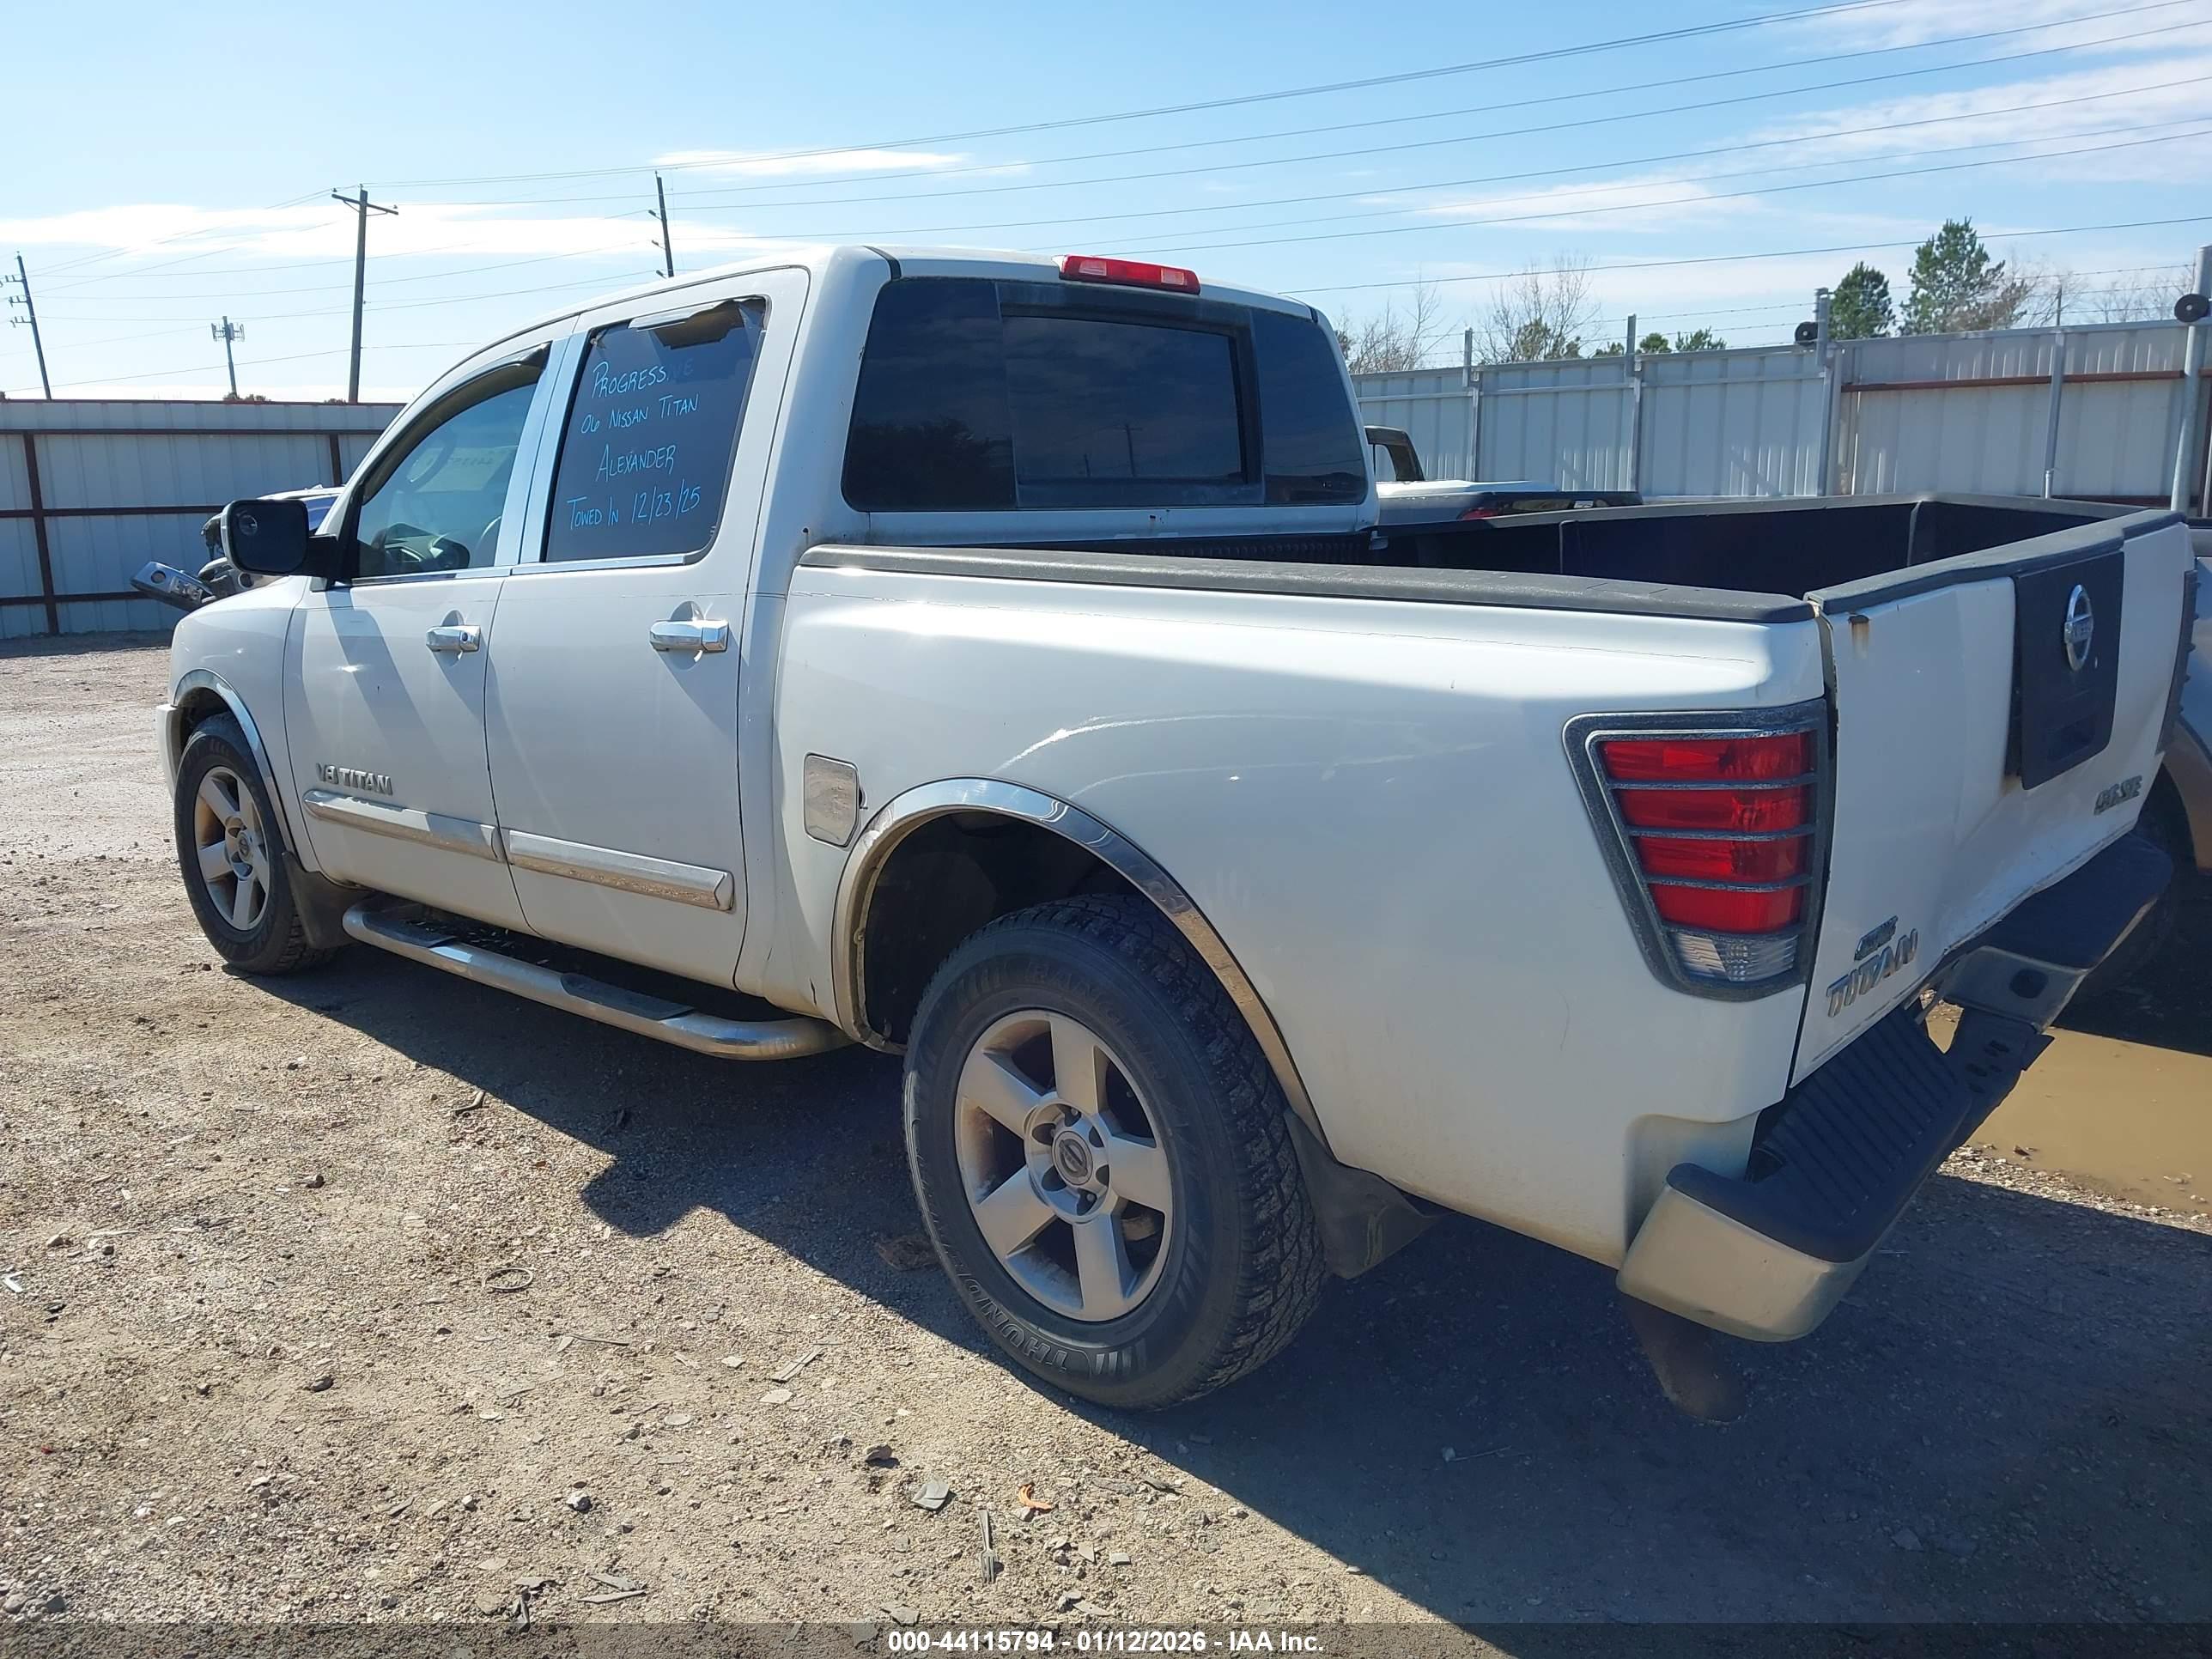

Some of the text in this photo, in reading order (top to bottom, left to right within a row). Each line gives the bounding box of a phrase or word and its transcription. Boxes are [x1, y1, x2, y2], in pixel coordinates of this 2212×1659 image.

[609, 406, 648, 429] NISSAN
[659, 394, 699, 419] TITAN
[596, 444, 677, 482] ALEXANDER
[567, 496, 602, 530] TOWED
[631, 478, 702, 526] 12/23/25
[338, 767, 393, 796] TITAN
[1826, 927, 1919, 1018] TITAN
